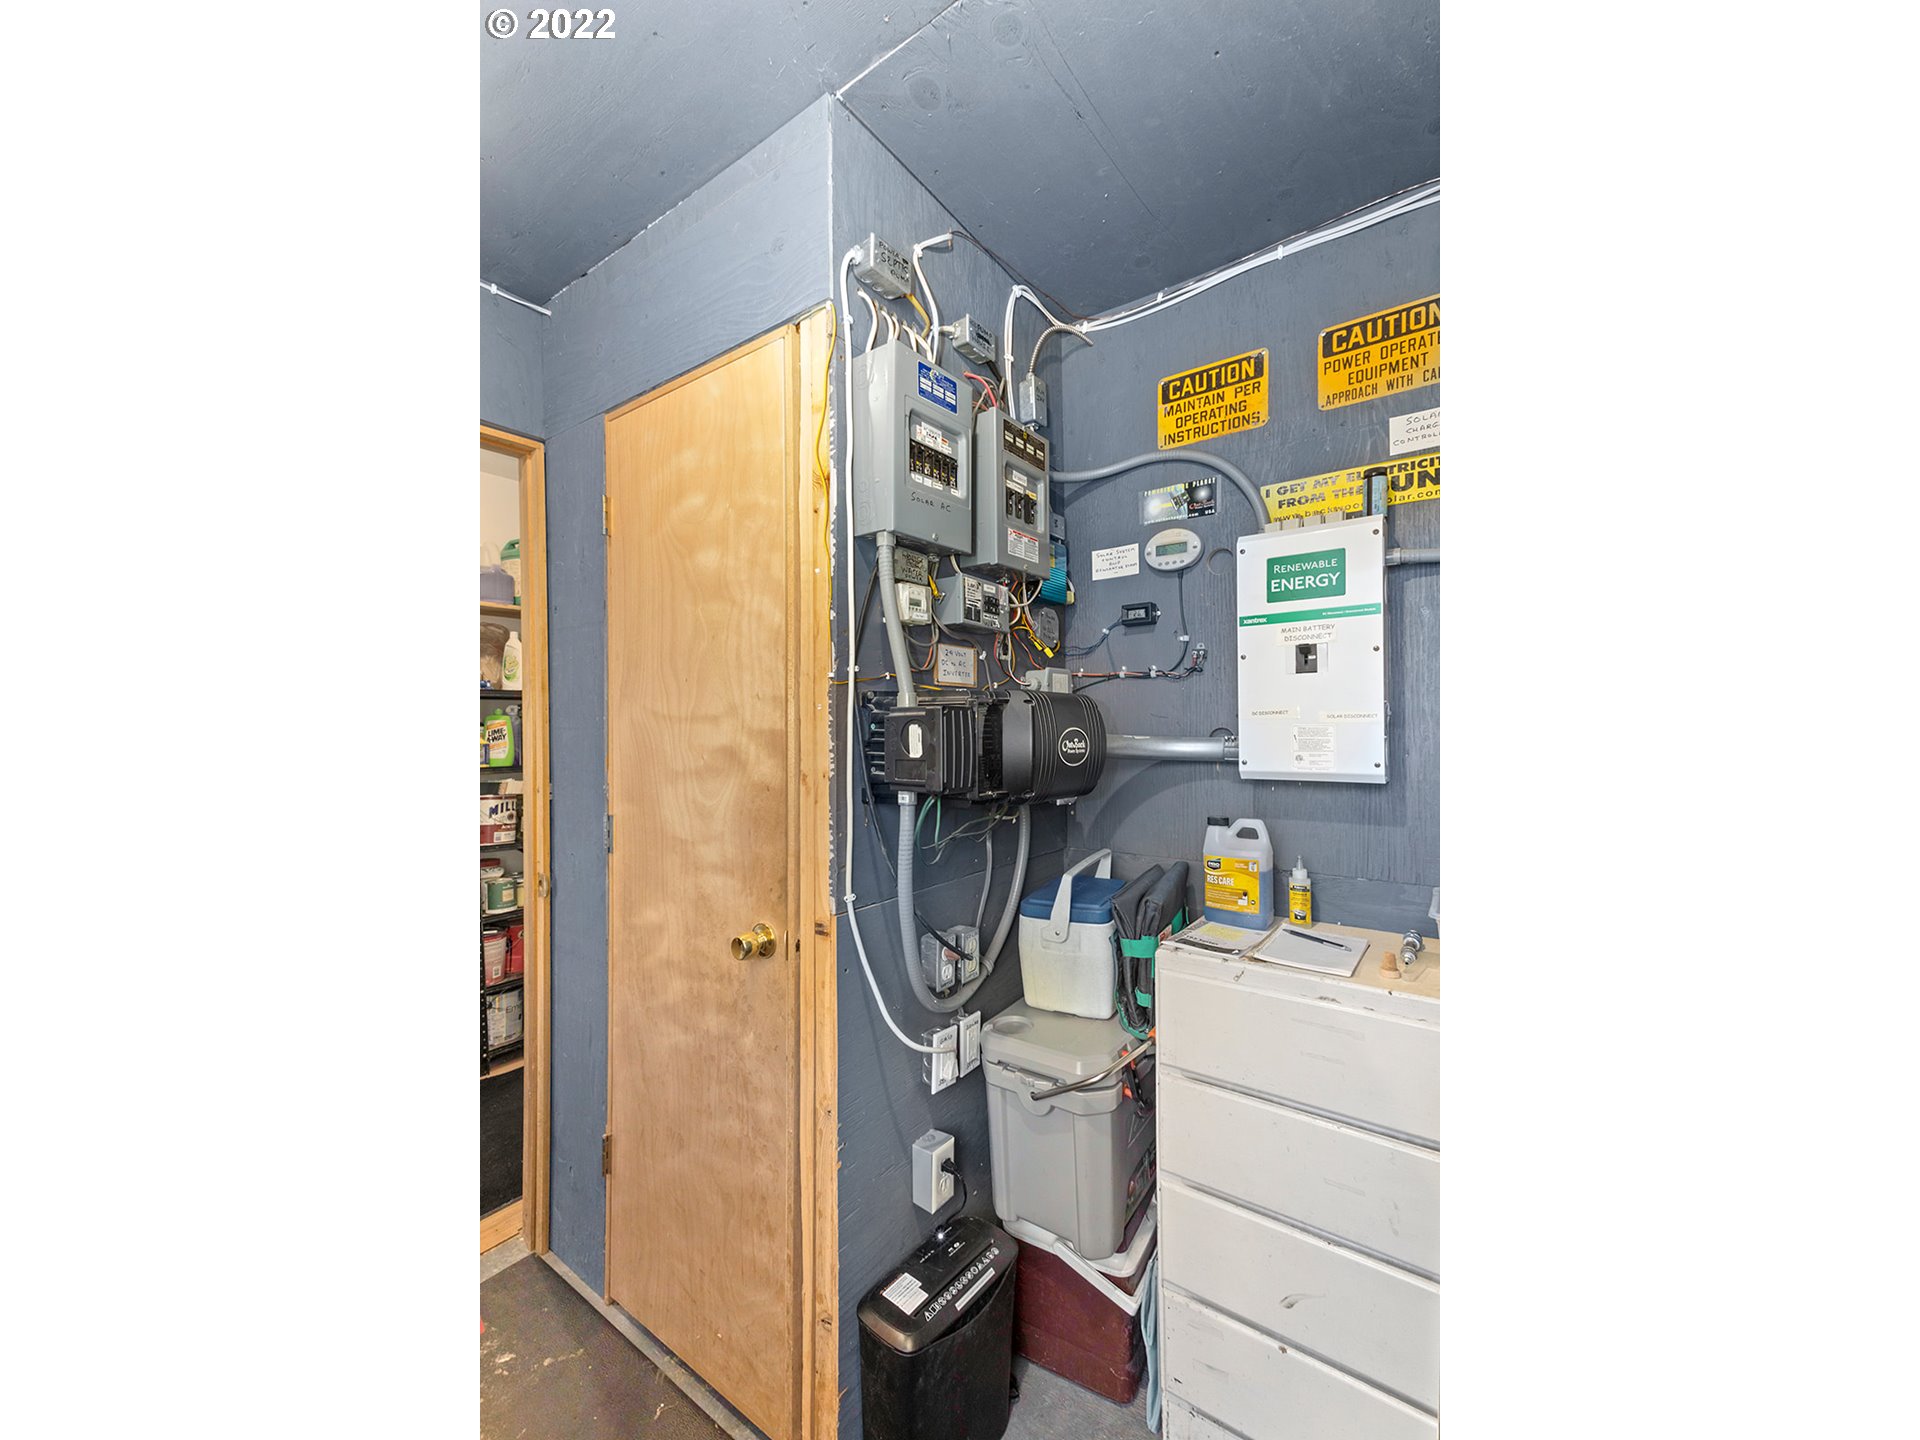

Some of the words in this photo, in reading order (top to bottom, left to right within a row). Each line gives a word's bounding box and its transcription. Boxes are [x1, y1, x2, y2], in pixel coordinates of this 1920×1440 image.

[1332, 302, 1440, 353] CAUTION
[1323, 350, 1371, 376] POWER
[1347, 351, 1430, 386] EQUIPMENT
[1168, 358, 1255, 400] CAUTION
[1325, 382, 1378, 408] APPROACH
[1386, 373, 1414, 391] WITH
[1163, 390, 1226, 418] MAINTAIN
[1234, 381, 1261, 399] PER
[1175, 400, 1248, 429] OPERATING
[1163, 411, 1261, 446] INSTRUCTIONS
[1392, 431, 1440, 447] CONTROL
[1405, 421, 1440, 434] CHARG
[1265, 489, 1271, 498] I
[1276, 481, 1307, 496] GET
[1312, 474, 1341, 489] MY
[1277, 492, 1326, 509] FROM
[1331, 484, 1364, 499] THE
[1387, 467, 1440, 492] UN
[910, 491, 935, 508] SOLAR
[940, 502, 952, 513] AC
[1273, 558, 1339, 575] RENEWABLE
[1270, 571, 1341, 593] ENERGY
[1281, 626, 1302, 634] MAIN
[1302, 623, 1336, 632] BATTERY
[1283, 632, 1333, 642] DISCONNECT
[1206, 874, 1218, 885] RES
[1218, 876, 1235, 887] CARE
